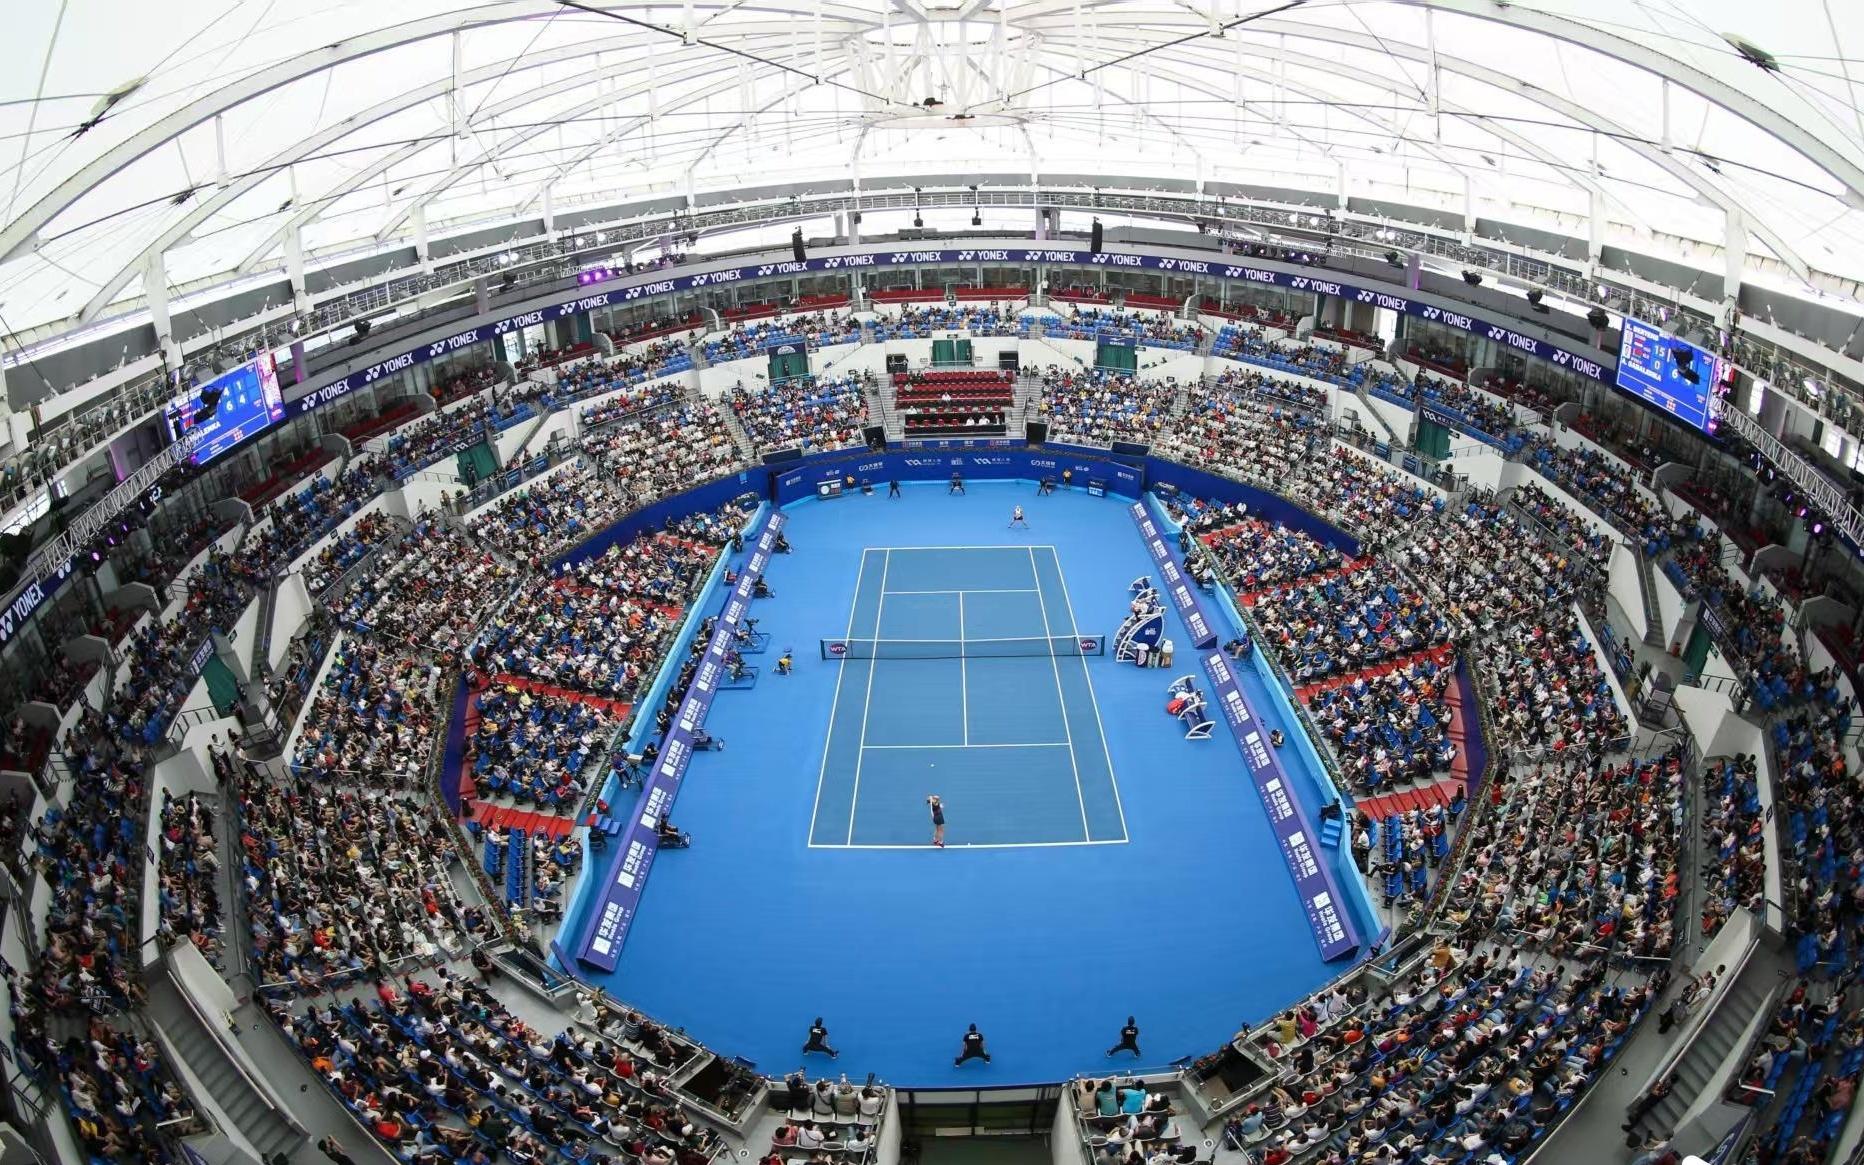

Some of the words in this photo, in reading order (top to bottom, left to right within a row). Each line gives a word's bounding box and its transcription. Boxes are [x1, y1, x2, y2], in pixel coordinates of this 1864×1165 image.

[843, 254, 874, 266] YONEX
[910, 252, 941, 262] YONEX
[978, 250, 1008, 260] YONEX
[1044, 252, 1075, 262] YONEX
[1112, 254, 1142, 266] YONEX
[777, 261, 808, 273] YONEX
[1178, 260, 1208, 273] YONEX
[710, 270, 741, 283] YONEX
[1244, 269, 1275, 283] YONEX
[644, 280, 674, 296] YONEX
[1310, 280, 1341, 296] YONEX
[578, 294, 608, 311] YONEX
[1376, 294, 1407, 311] YONEX
[512, 310, 543, 329] YONEX
[1442, 310, 1472, 331] YONEX
[447, 330, 478, 351] YONEX
[1507, 332, 1538, 353] YONEX
[1654, 346, 1666, 357] 15
[383, 353, 414, 375] YONEX
[1572, 356, 1602, 380] YONEX
[1654, 360, 1660, 370] 0
[1672, 369, 1678, 379] 6
[223, 386, 230, 397] 4
[236, 380, 242, 390] 1
[318, 378, 350, 402] YONEX
[226, 400, 234, 411] 6
[239, 394, 246, 404] 4
[12, 581, 45, 622] YONEX
